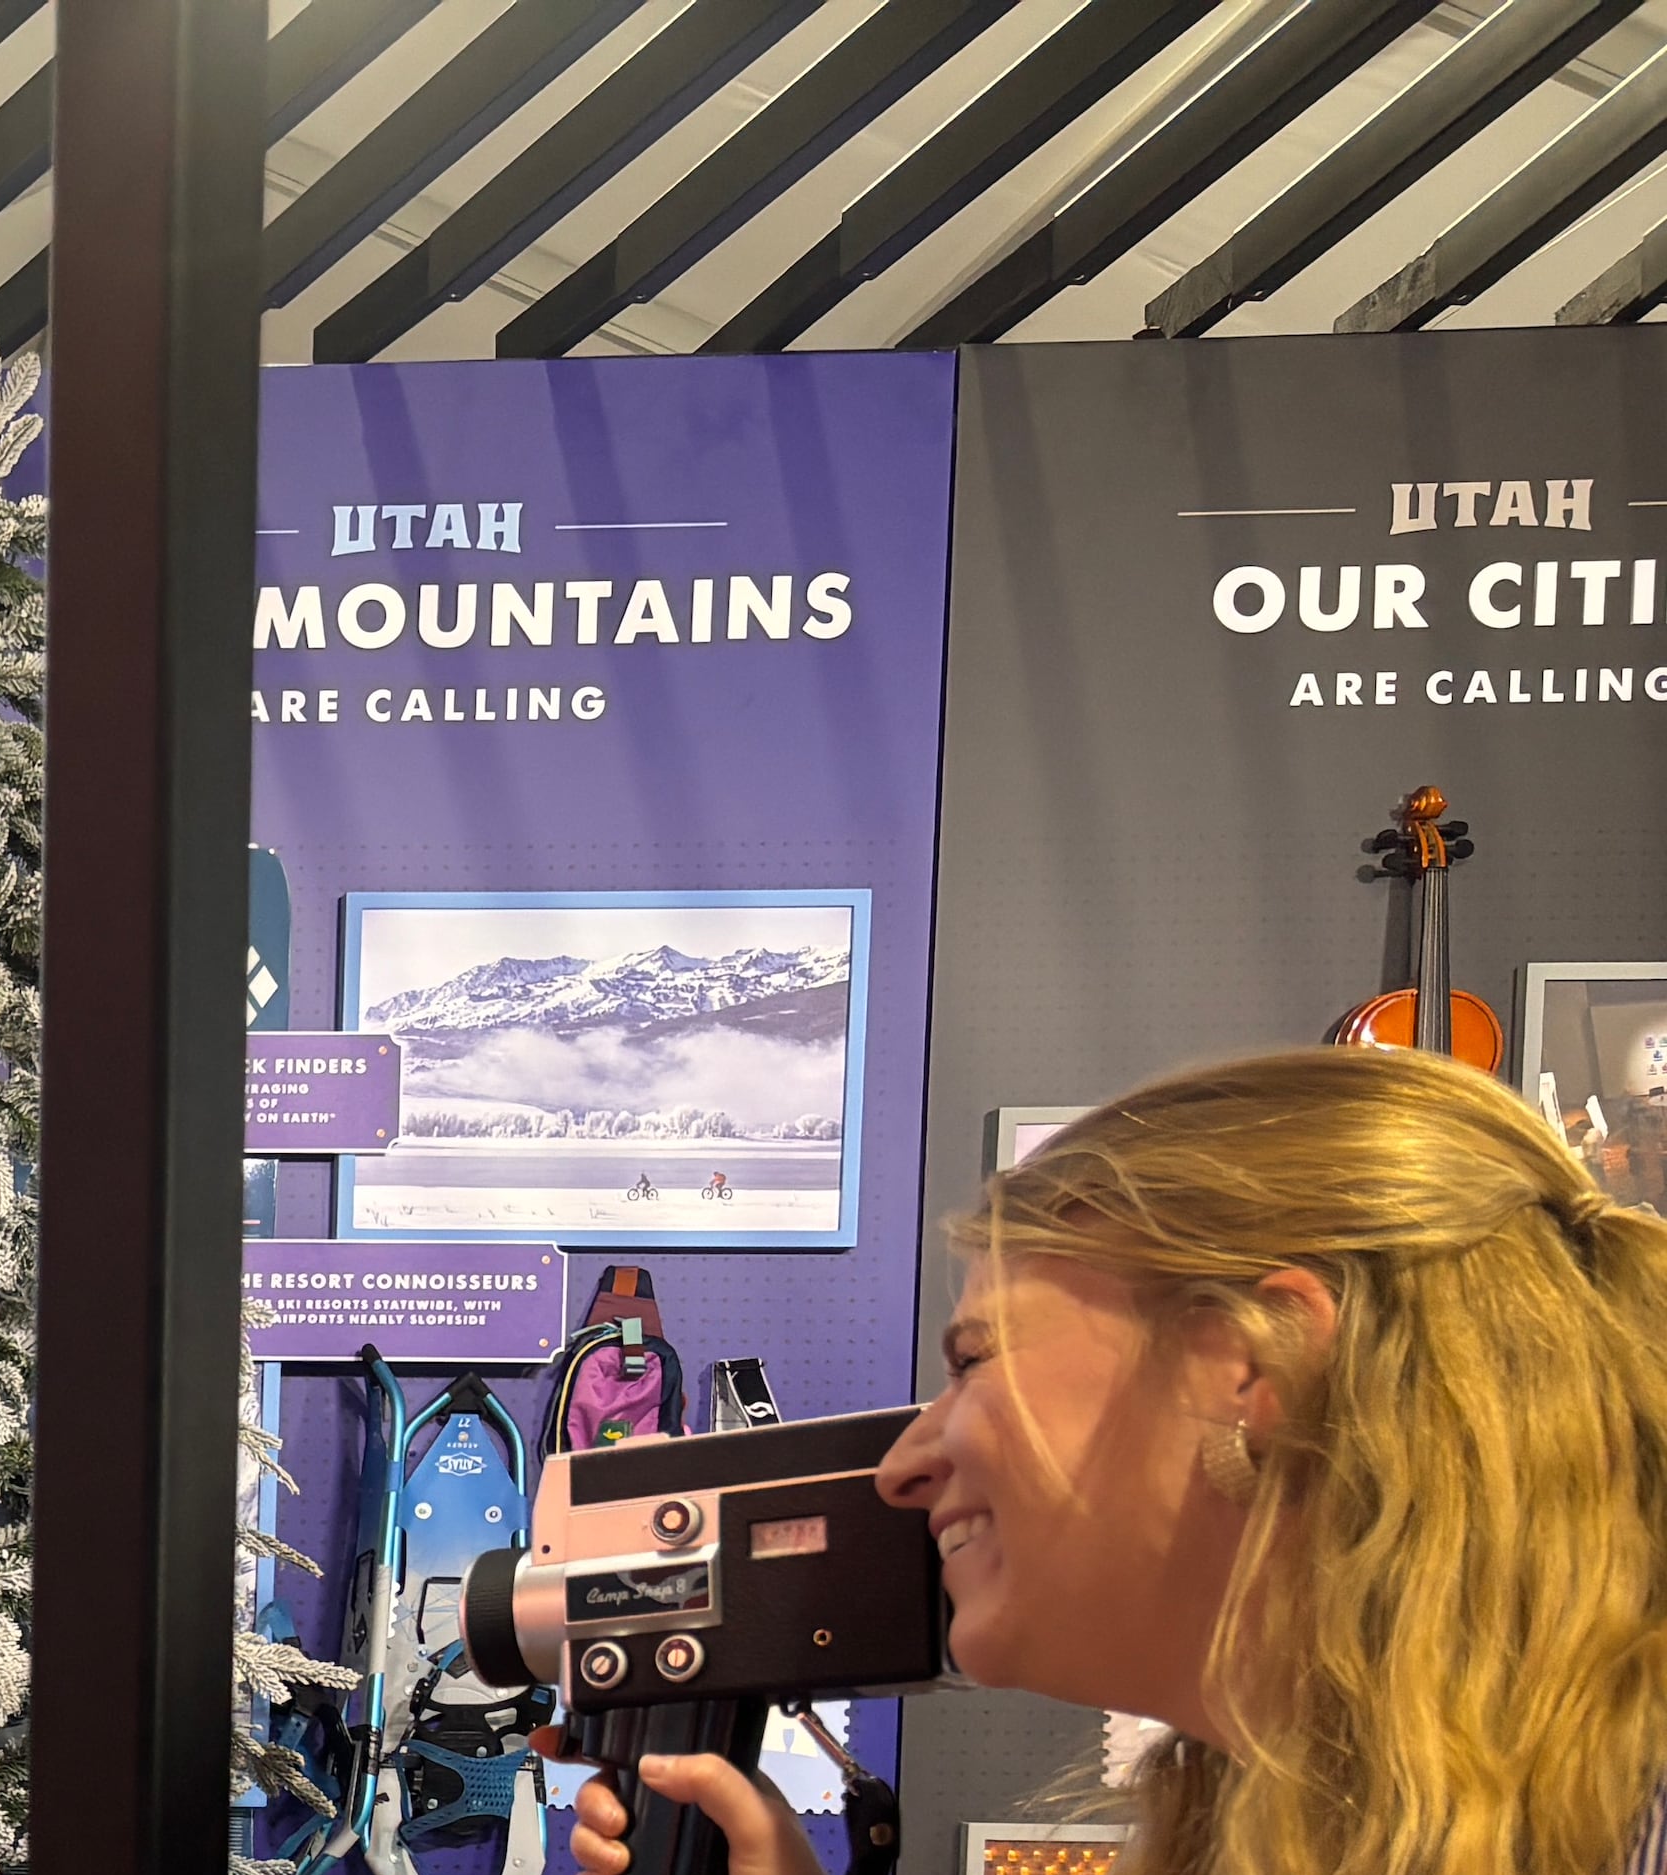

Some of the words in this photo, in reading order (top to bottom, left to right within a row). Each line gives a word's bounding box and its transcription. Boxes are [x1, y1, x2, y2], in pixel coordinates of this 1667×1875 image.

[1389, 478, 1594, 535] UTAH
[331, 502, 524, 557] UTAH
[1212, 563, 1429, 634] OUR
[253, 571, 854, 650] MOUNTAINS
[1289, 671, 1398, 706] ARE
[1425, 666, 1667, 704] CALLING
[366, 686, 607, 723] CALLING
[274, 1058, 367, 1075] FINDERS
[259, 1098, 278, 1109] OF
[256, 1112, 279, 1123] ON
[271, 1273, 354, 1290] RESORT
[362, 1273, 538, 1291] CONNOISSEURS
[277, 1299, 301, 1311] SKI
[305, 1299, 371, 1311] RESORTS
[374, 1299, 458, 1313] STATEWIDE,
[464, 1299, 501, 1311] WITH
[273, 1313, 345, 1325] AIRPORTS
[349, 1313, 405, 1326] NEARLY
[410, 1314, 487, 1326] SLOPESIDE
[447, 1459, 474, 1471] ATLAS
[586, 1587, 629, 1606] Camp
[633, 1582, 673, 1600] Snap
[676, 1578, 687, 1594] 8
